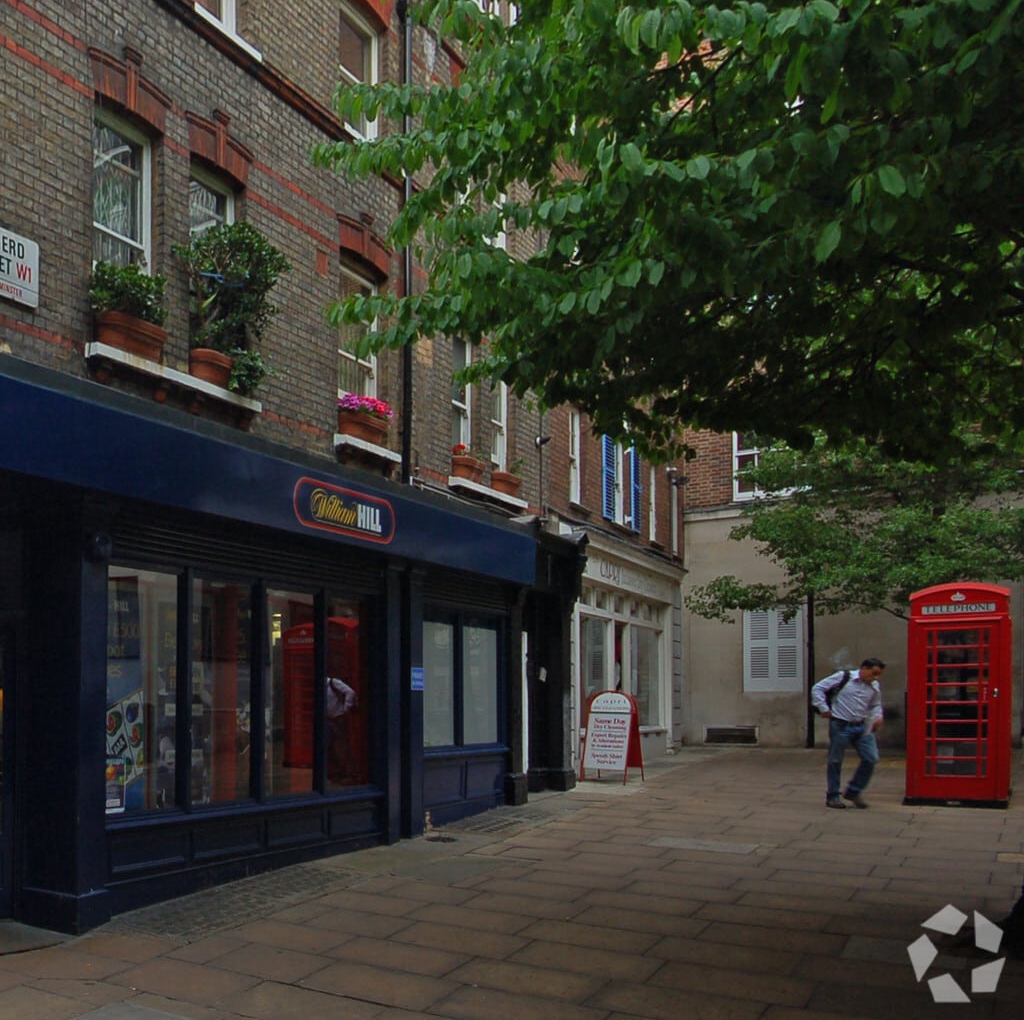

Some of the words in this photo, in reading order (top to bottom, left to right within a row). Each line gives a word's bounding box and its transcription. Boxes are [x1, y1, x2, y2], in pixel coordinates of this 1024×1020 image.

[16, 262, 32, 284] W1
[311, 488, 357, 526] William
[357, 503, 382, 533] HILL
[926, 603, 993, 613] TELEPHONE
[594, 717, 612, 725] Same
[613, 718, 626, 726] Day
